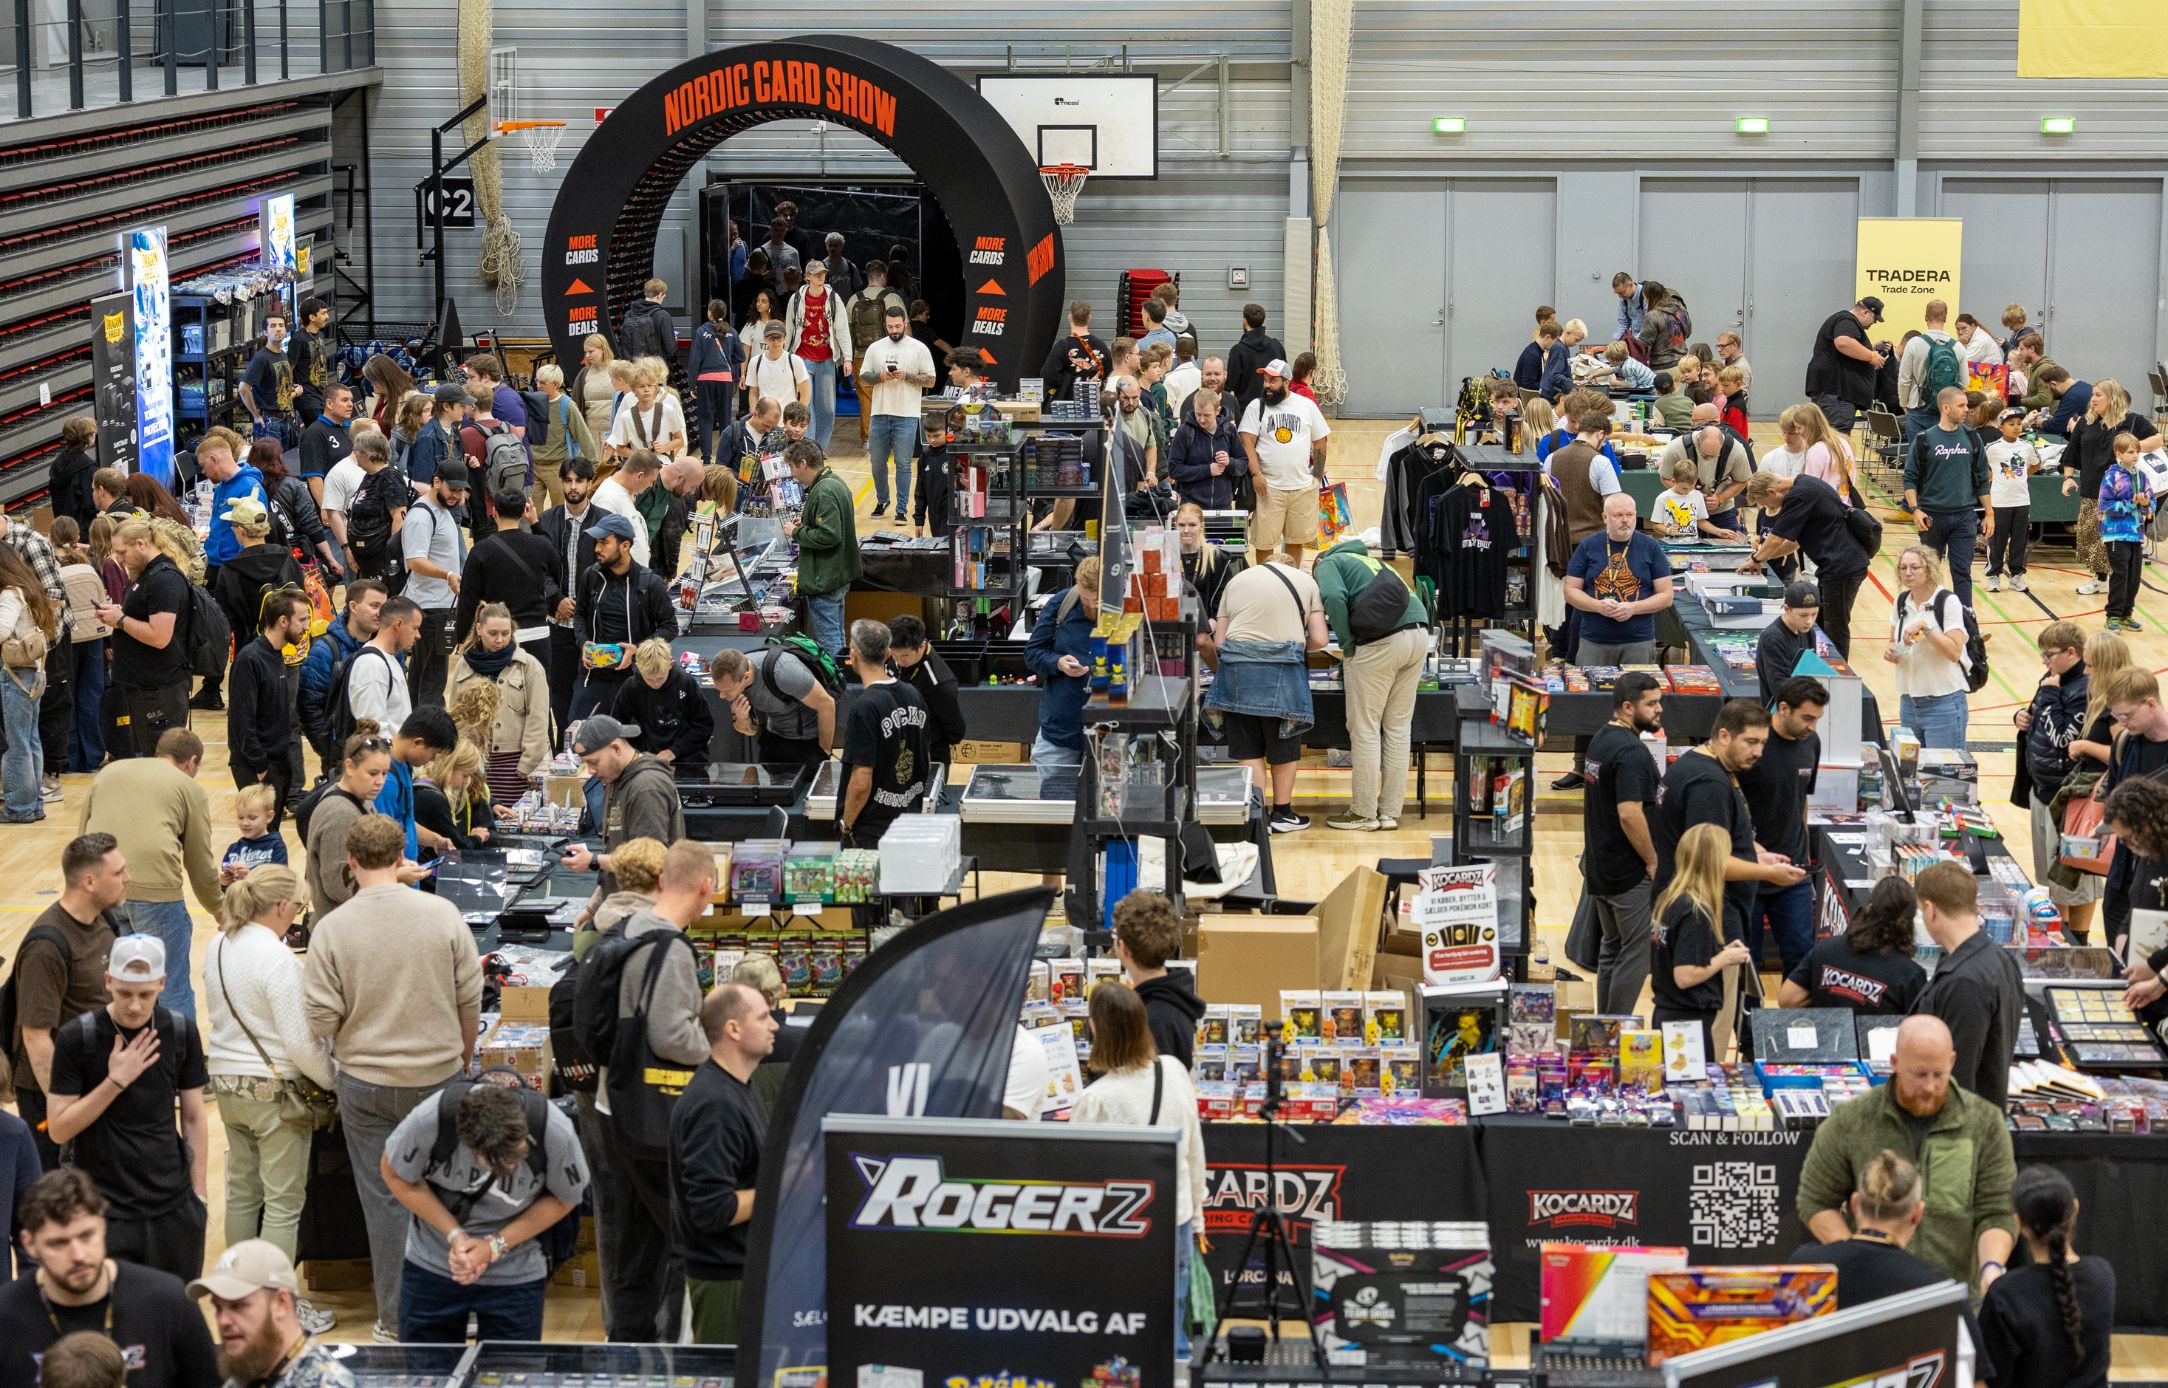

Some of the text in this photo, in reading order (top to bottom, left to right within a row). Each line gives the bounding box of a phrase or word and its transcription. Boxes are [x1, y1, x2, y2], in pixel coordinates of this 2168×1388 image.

[664, 60, 897, 138] NORDIC CARD SHOW
[568, 234, 597, 250] MORE
[975, 236, 1006, 251] MORE
[565, 248, 599, 265] CARDS
[969, 250, 1005, 266] CARDS
[1866, 269, 1951, 282] TRADERA
[1881, 285, 1935, 294] Trade Zone
[569, 305, 597, 322] MORE
[976, 306, 1008, 322] MORE
[568, 320, 598, 337] DEALS
[971, 320, 1005, 336] DEALS
[329, 435, 340, 449] 3
[1934, 442, 1970, 460] Rapha.
[1432, 870, 1484, 889] KOCARDZ
[1821, 968, 1883, 1003] KOCARDZ
[1669, 1130, 1801, 1146] SCAN & FOLLOW
[1532, 1193, 1635, 1221] KOCARDZ
[854, 1303, 1147, 1335] KÆMPE UDVALG AF
